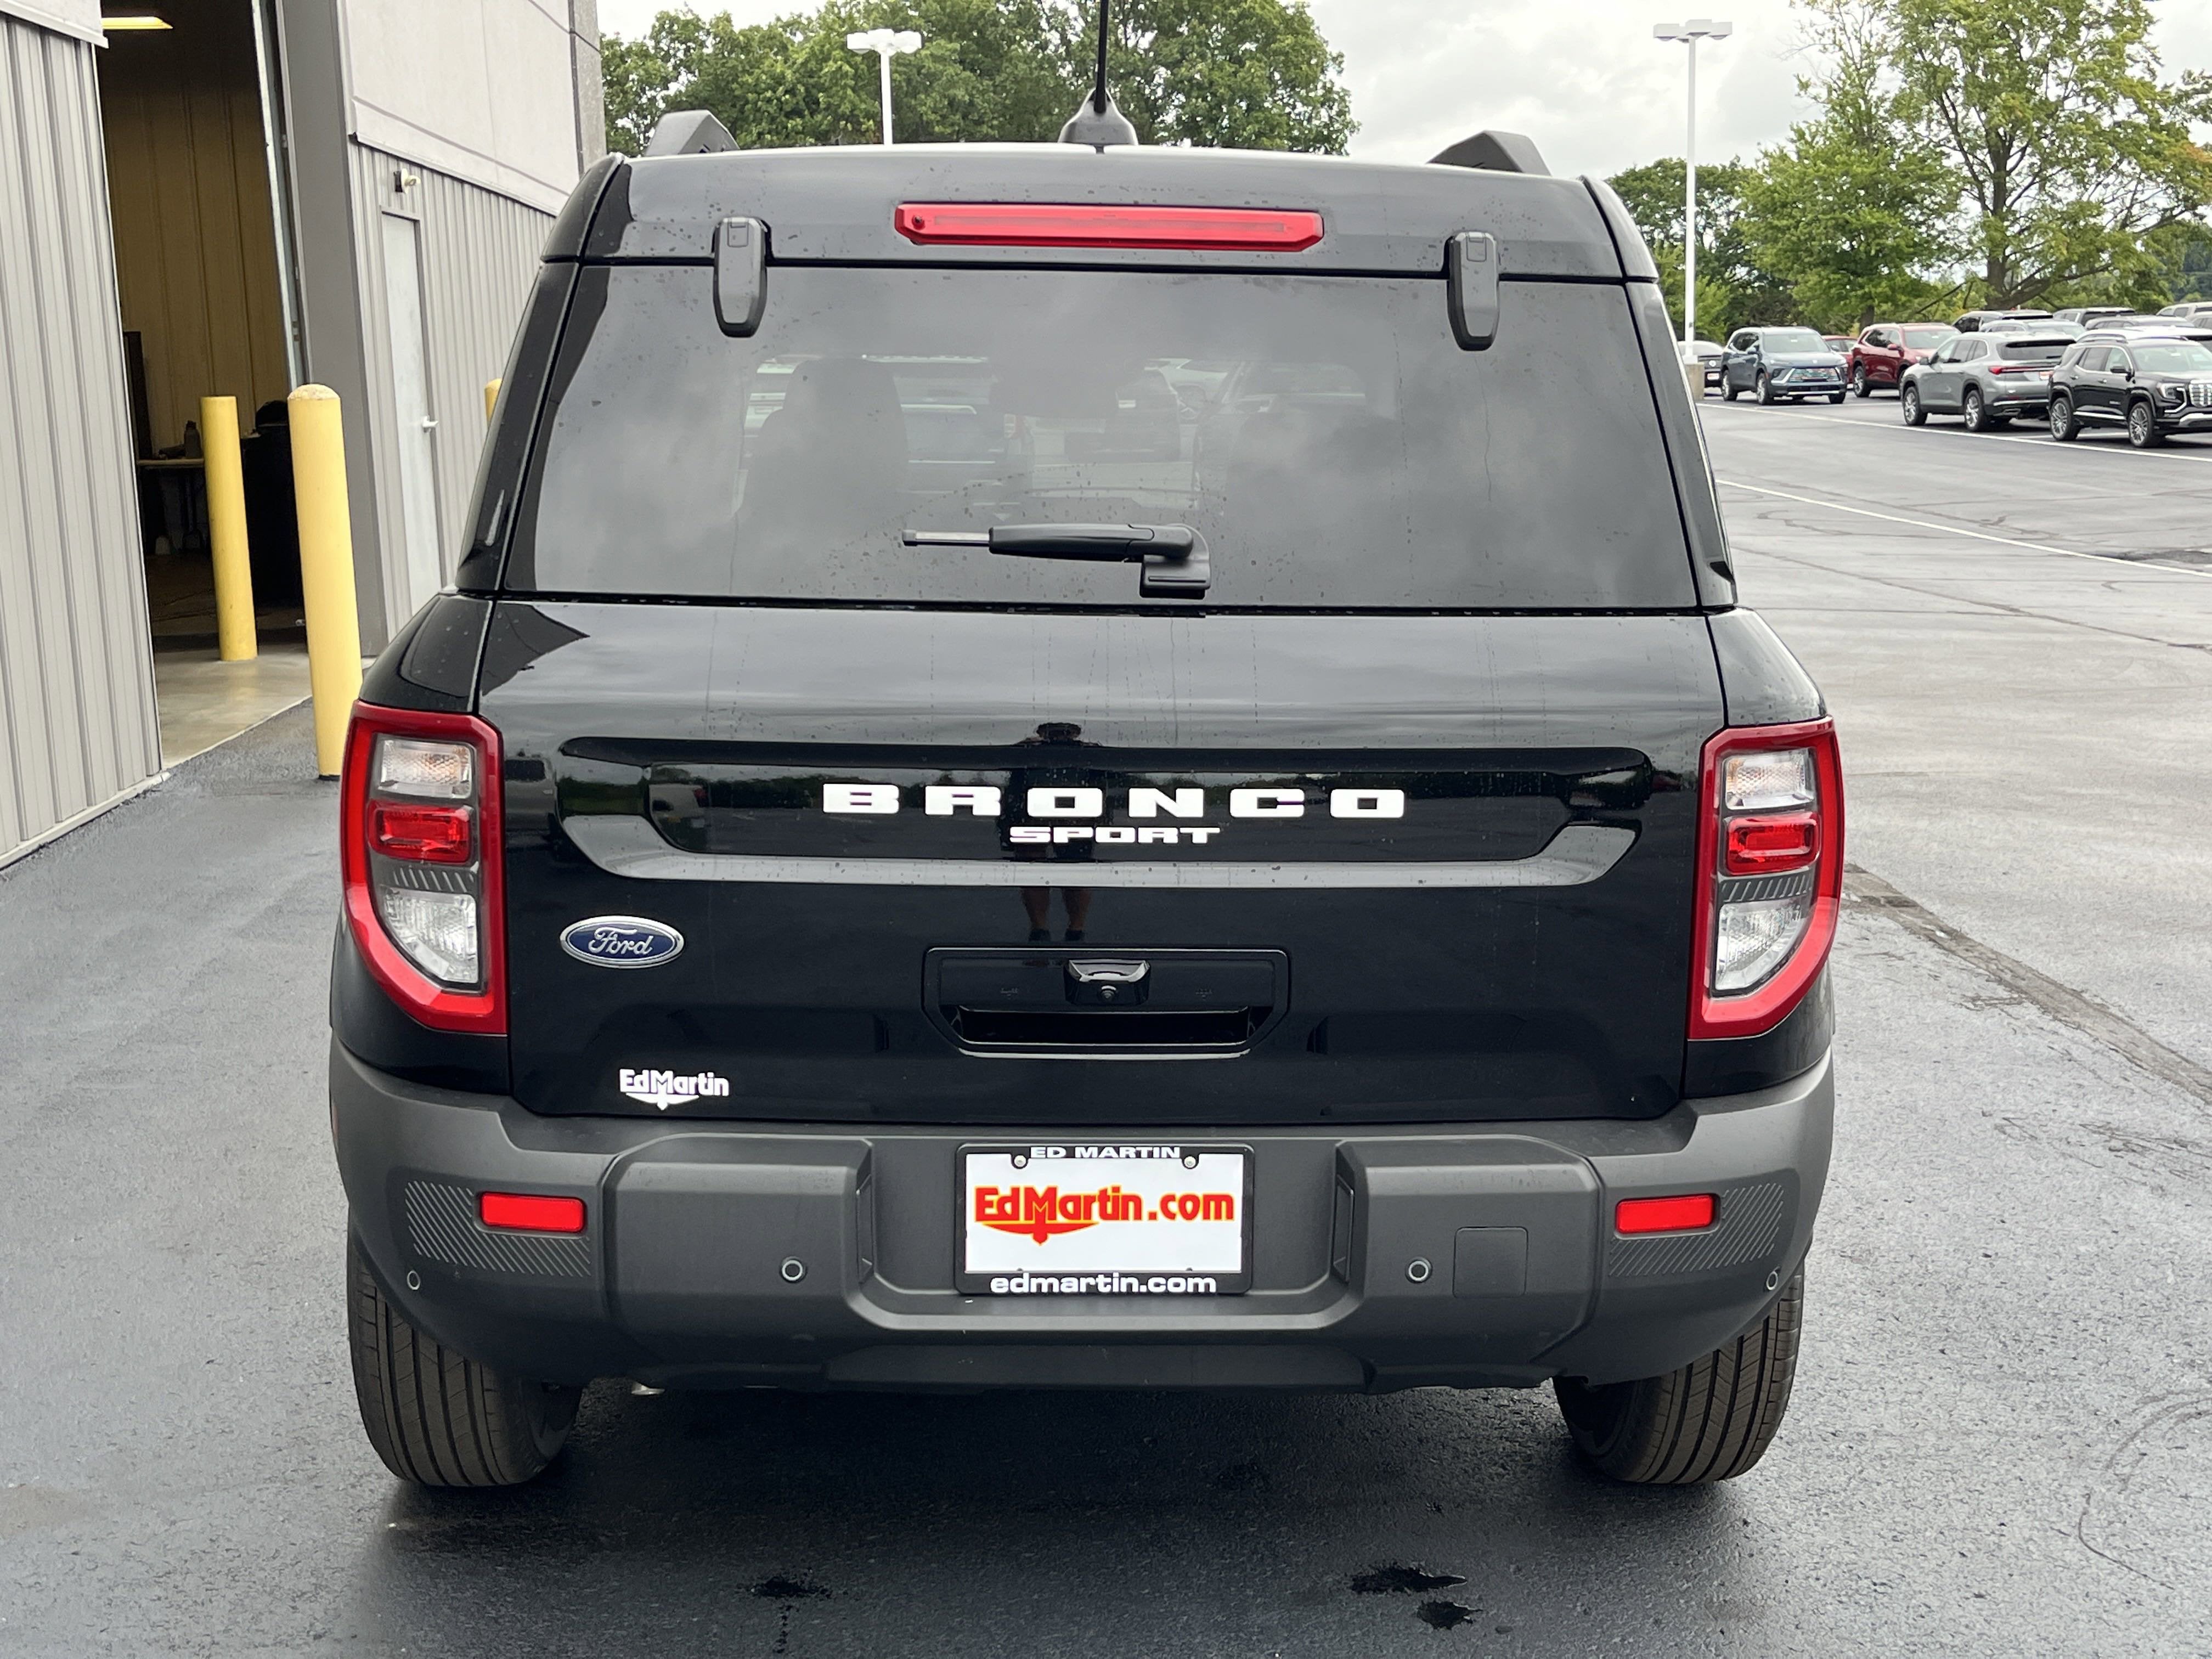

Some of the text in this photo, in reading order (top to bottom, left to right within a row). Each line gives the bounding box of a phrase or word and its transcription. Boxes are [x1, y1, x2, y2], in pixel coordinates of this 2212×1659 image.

[822, 783, 1405, 819] BRONCO
[1009, 826, 1221, 844] SPORT
[588, 926, 653, 955] Ford
[619, 1068, 730, 1097] EdMartin
[1030, 1146, 1181, 1159] ED MARTIN
[990, 1272, 1217, 1294] edmartin.com
